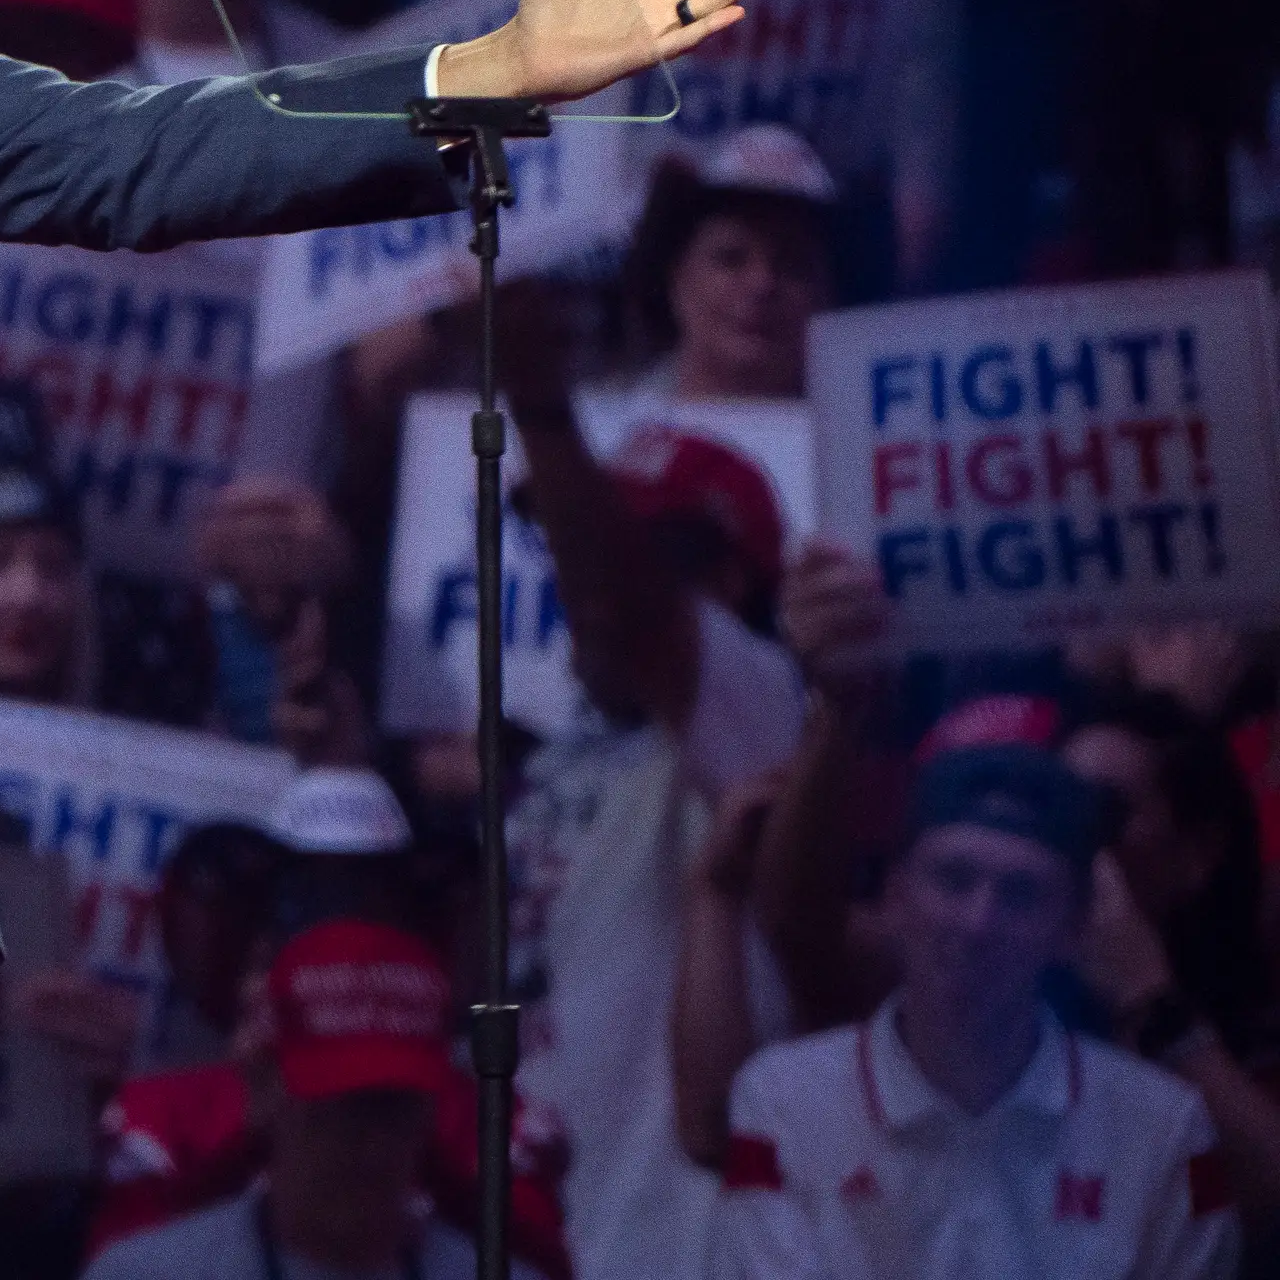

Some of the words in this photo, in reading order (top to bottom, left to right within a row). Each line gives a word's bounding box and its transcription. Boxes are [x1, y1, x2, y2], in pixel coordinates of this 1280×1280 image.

[872, 327, 1200, 426] FIGHT!
[874, 416, 1214, 514] FIGHT!
[878, 500, 1227, 600] FIGHT!
